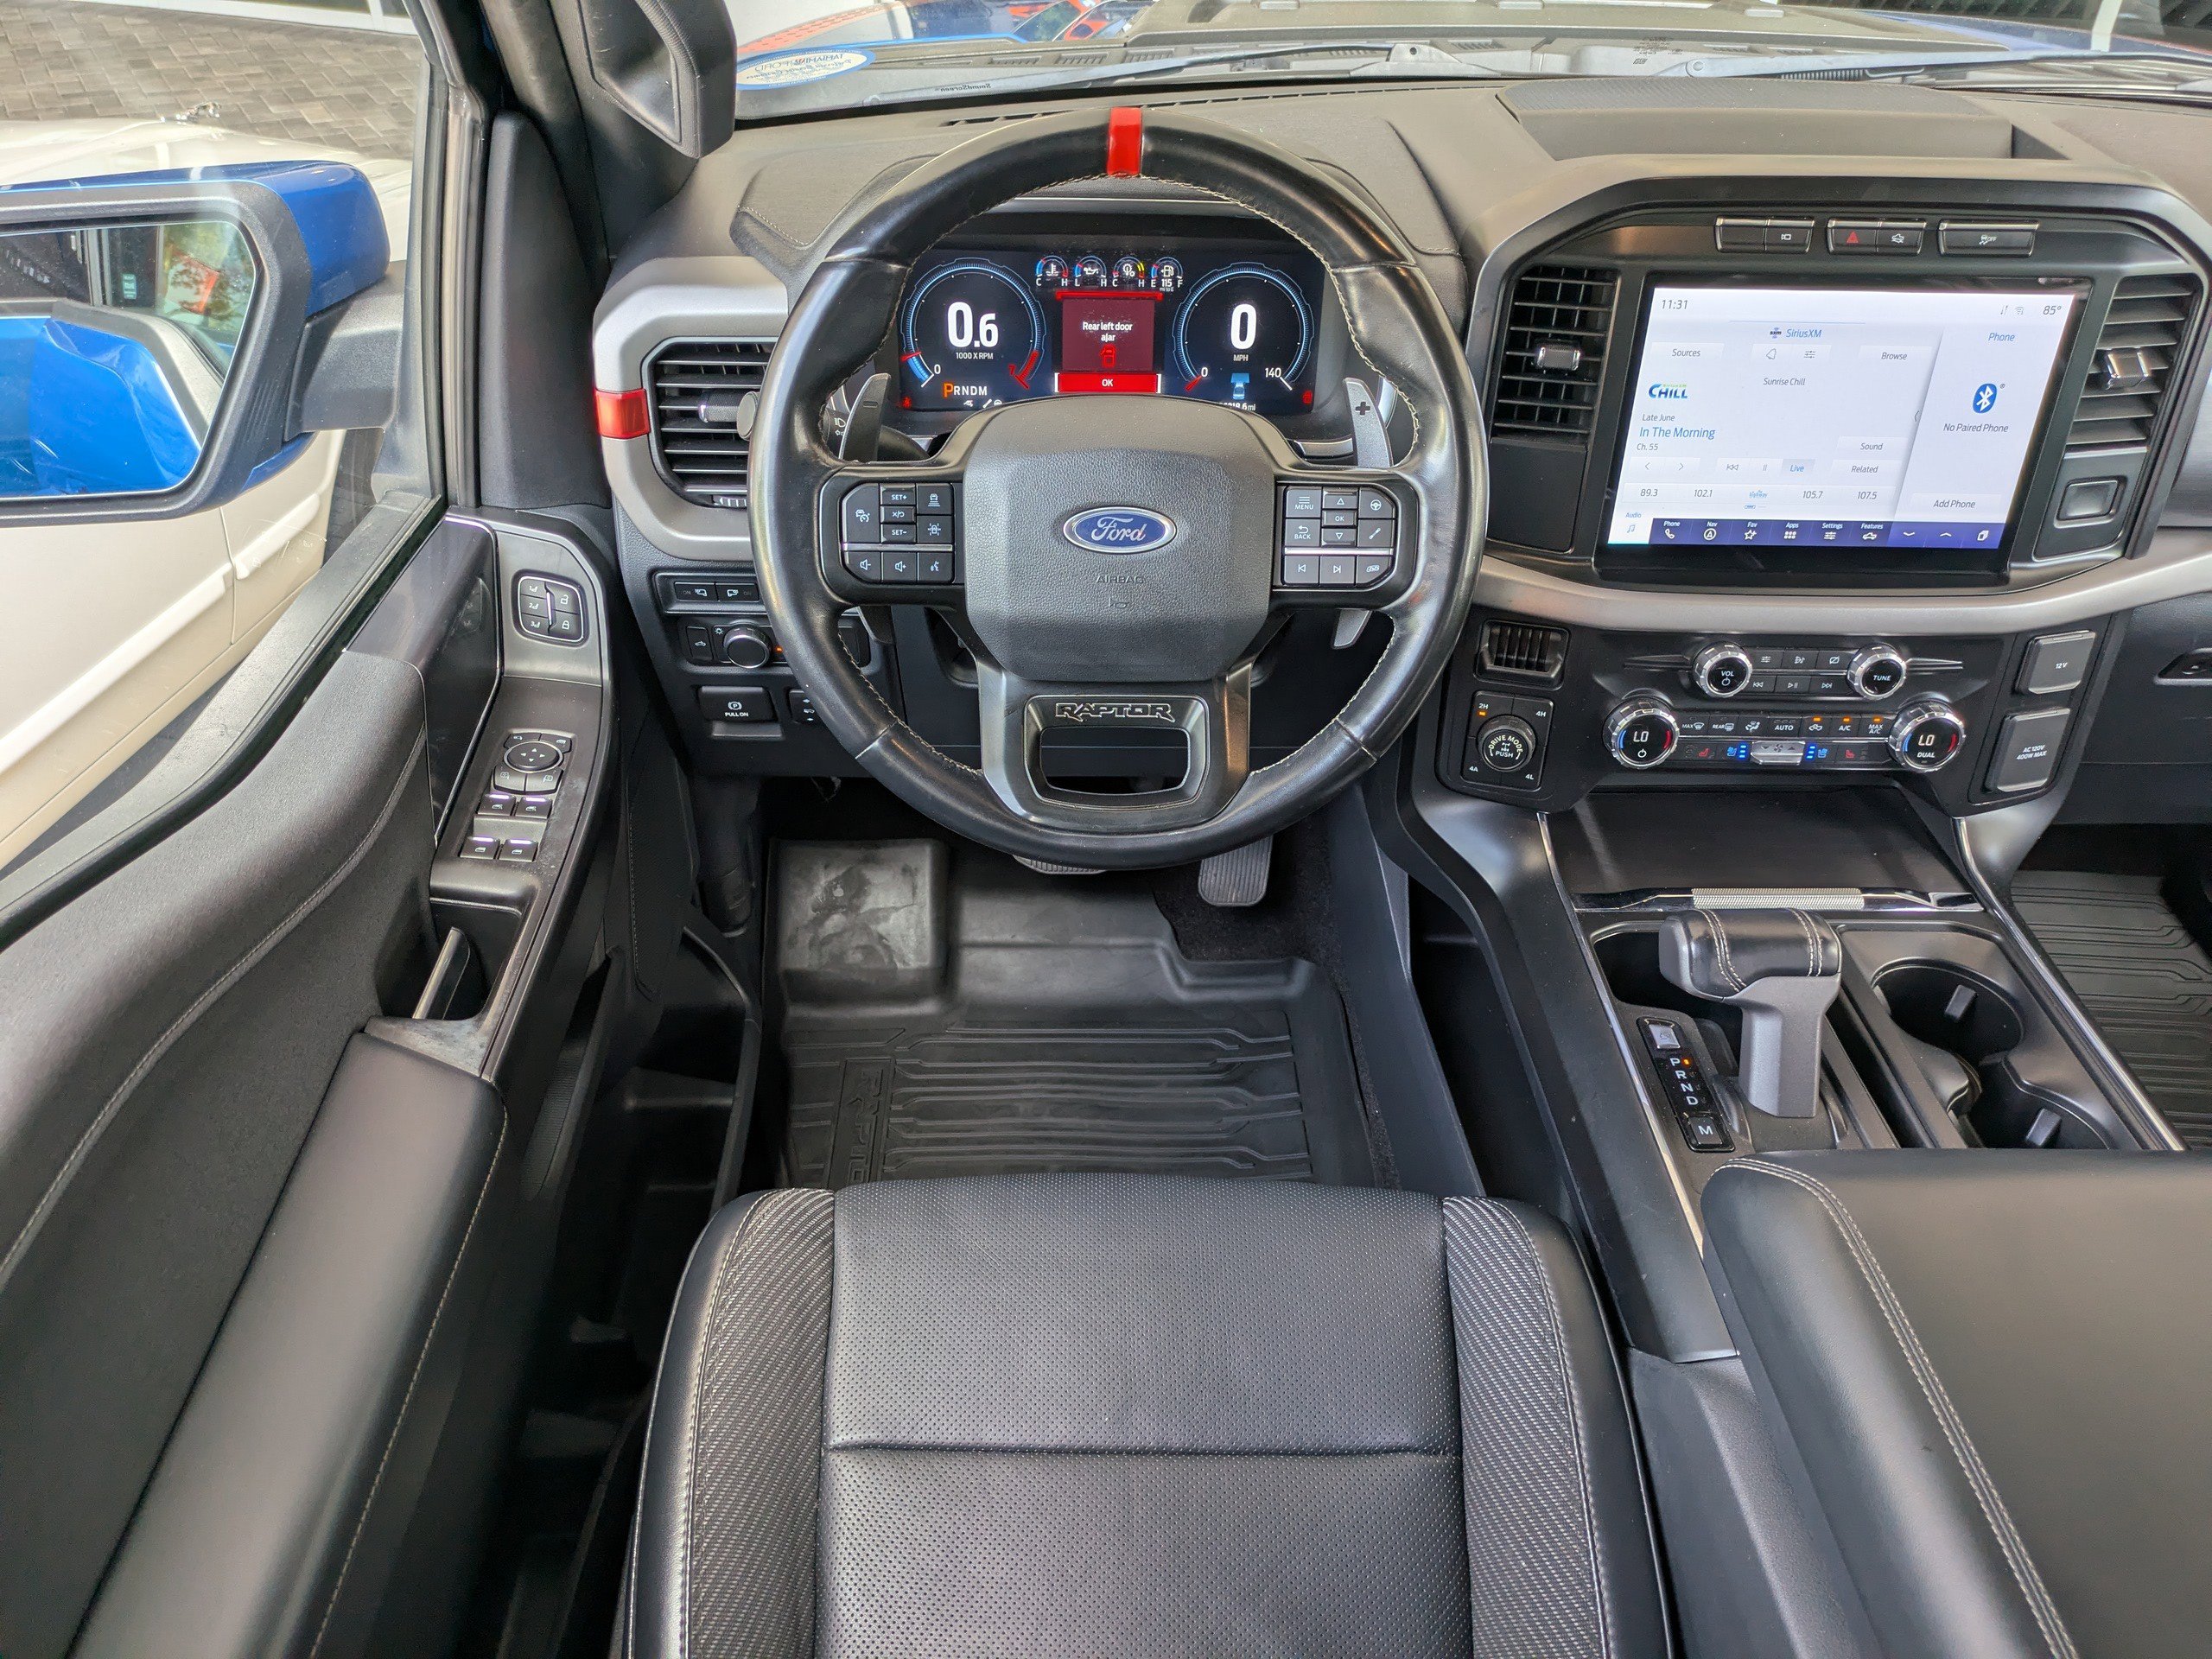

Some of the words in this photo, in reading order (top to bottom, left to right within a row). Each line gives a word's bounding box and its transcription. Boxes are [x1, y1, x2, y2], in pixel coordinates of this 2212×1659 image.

[1161, 278, 1173, 287] 115
[1662, 299, 1688, 309] 11:31
[947, 301, 999, 348] 0.6
[1083, 321, 1100, 330] Rear
[1101, 321, 1114, 330] left
[1115, 321, 1133, 330] door
[1230, 304, 1257, 350] 0
[1101, 333, 1116, 342] ajar
[1786, 328, 1822, 338] SiriusXM
[1988, 332, 2015, 343] Phone
[1672, 348, 1701, 359] Sources
[1881, 352, 1908, 360] Browse
[934, 364, 941, 374] 0
[1201, 367, 1209, 378] 0
[1265, 367, 1281, 378] 140
[1102, 378, 1114, 387] OK
[1763, 377, 1789, 385] Sunrise
[1789, 378, 1806, 386] Chill
[1649, 384, 1688, 398] CHILL
[1642, 413, 1658, 422] Late
[1659, 413, 1675, 422] June
[1943, 423, 1955, 432] No
[1955, 423, 1983, 432] Paired
[1983, 423, 2009, 432] Phone
[1639, 427, 1649, 437] In
[1652, 427, 1671, 437] The
[1673, 427, 1716, 440] Morning
[1637, 442, 1648, 451] Ch.
[1851, 465, 1878, 474] Related
[1640, 488, 1658, 497] 89.3
[1694, 489, 1713, 498] 102.1
[1802, 490, 1823, 499] 105.7
[1857, 491, 1878, 499] 107.5
[1933, 499, 1950, 508] Add
[1090, 516, 1147, 542] Ford
[1096, 575, 1145, 584] AIRBAG
[1055, 702, 1176, 722] RAPTOR
[1488, 734, 1507, 750] DRIVE
[1507, 735, 1523, 753] MODE
[1669, 1058, 1681, 1067] P
[1675, 1070, 1688, 1079] R
[1681, 1083, 1694, 1092] N
[1687, 1096, 1699, 1105] D
[1698, 1125, 1713, 1135] M
